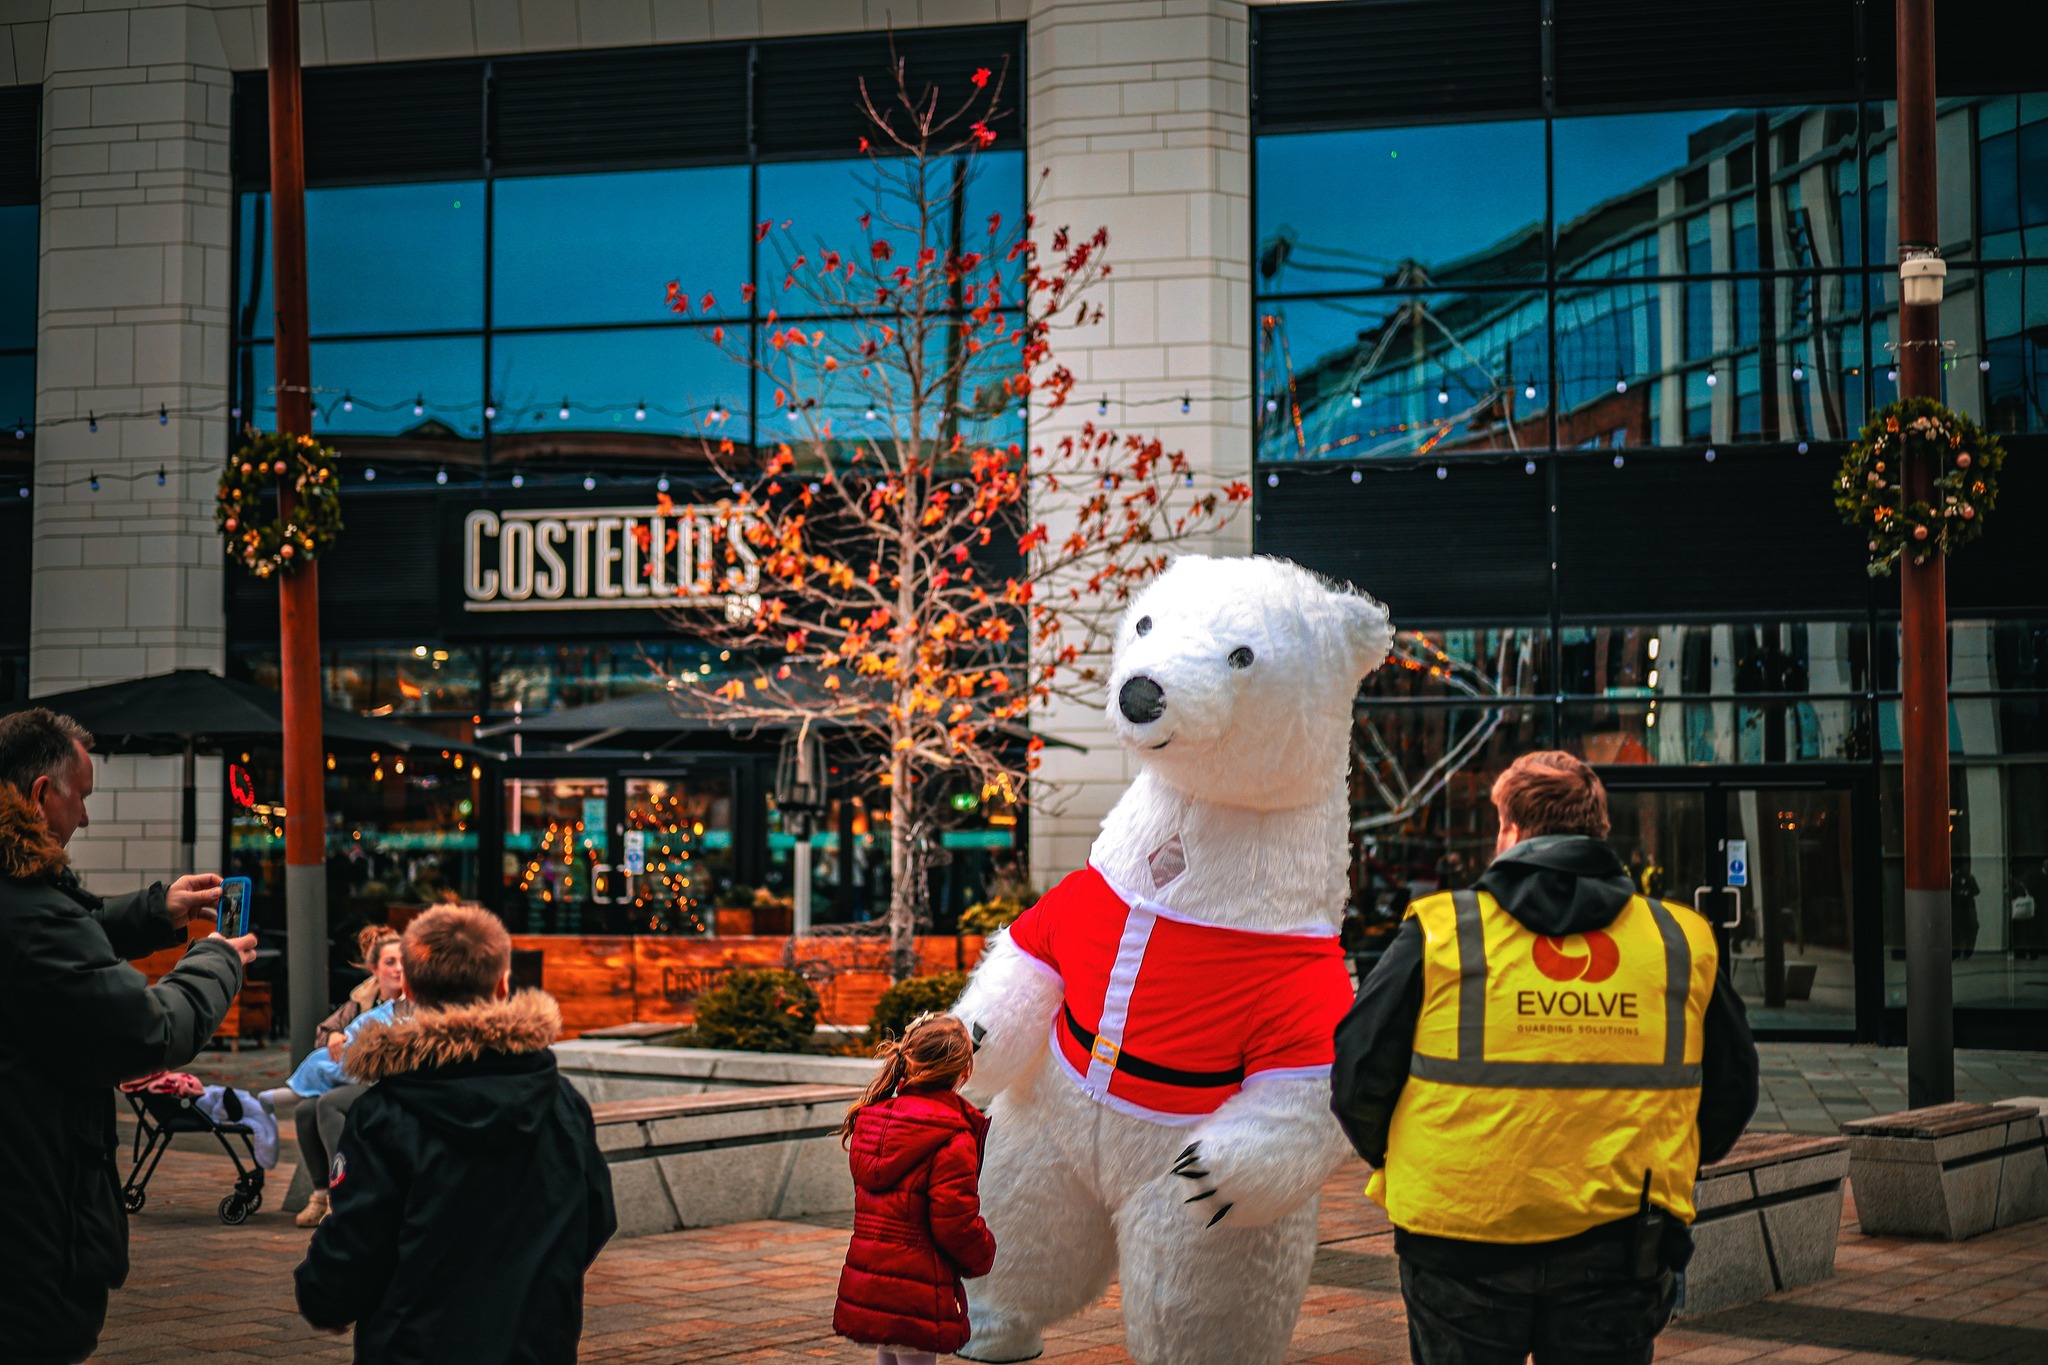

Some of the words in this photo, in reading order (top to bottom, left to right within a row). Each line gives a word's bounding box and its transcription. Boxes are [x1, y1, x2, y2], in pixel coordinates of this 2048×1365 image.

[464, 509, 761, 600] COSTELLO'S
[1517, 990, 1638, 1018] EVOLVE
[1516, 1024, 1573, 1034] GUARDING
[1578, 1025, 1639, 1036] SOLUTIONS
